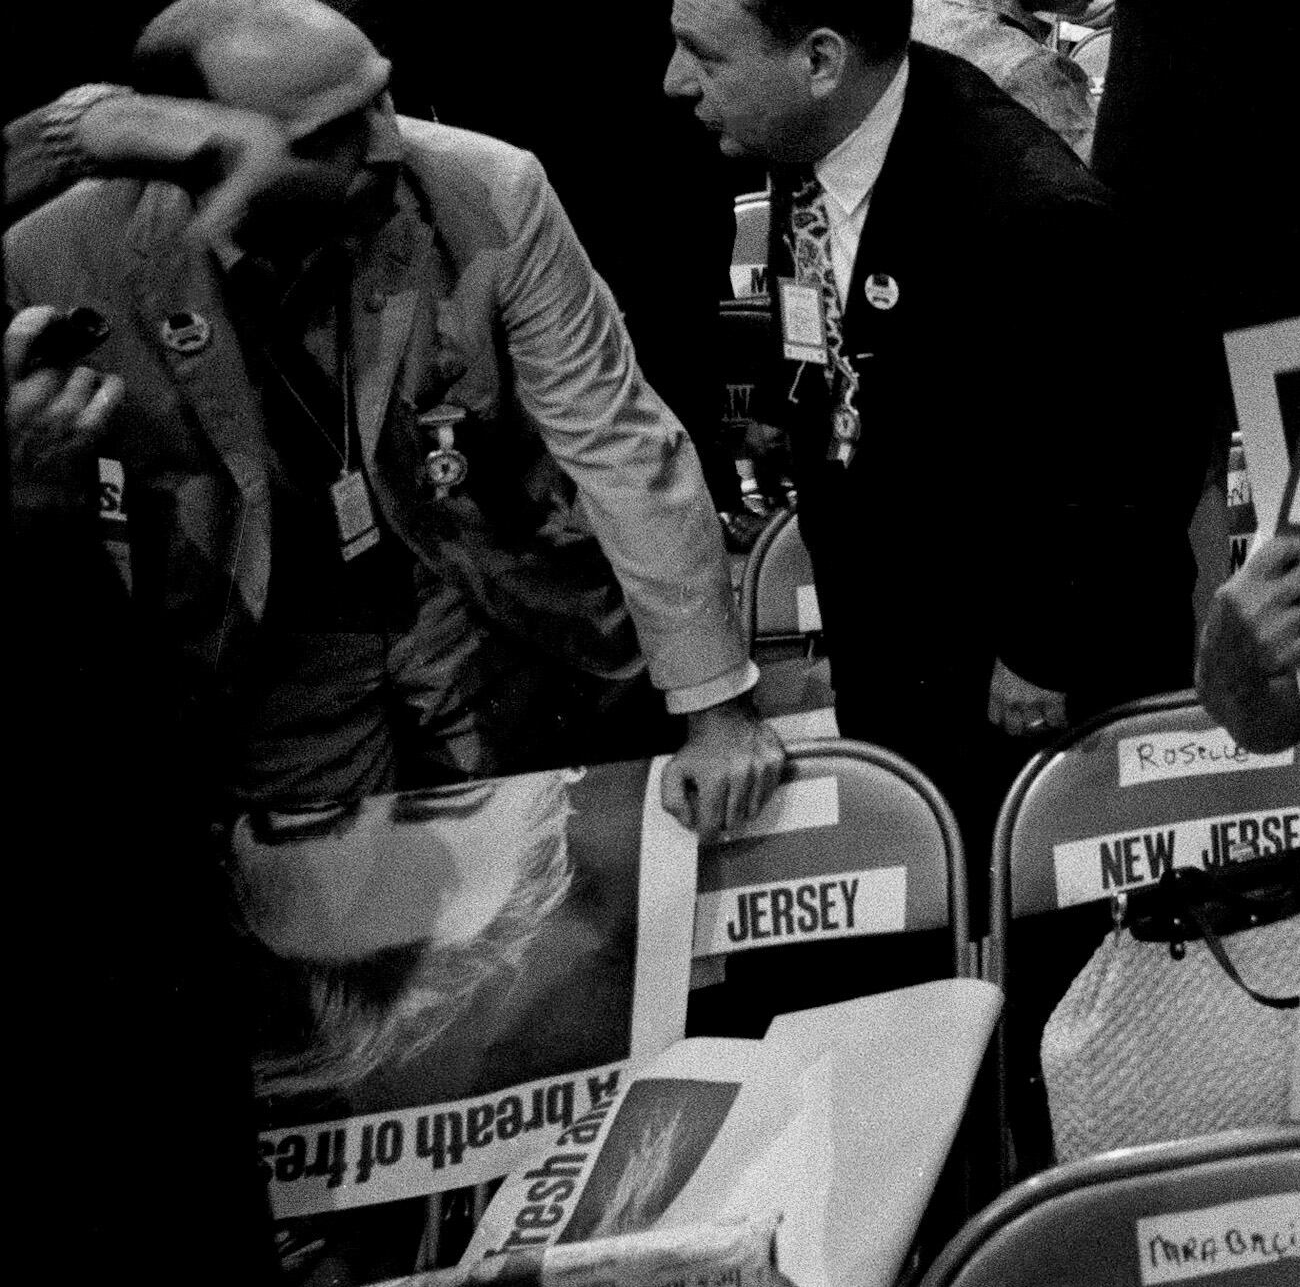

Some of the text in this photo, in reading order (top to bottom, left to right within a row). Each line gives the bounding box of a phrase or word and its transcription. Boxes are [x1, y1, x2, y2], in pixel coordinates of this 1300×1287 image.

[1099, 830, 1176, 891] NEW
[727, 878, 860, 943] JERSEY
[354, 1119, 405, 1184] of
[415, 1079, 576, 1170] breath
